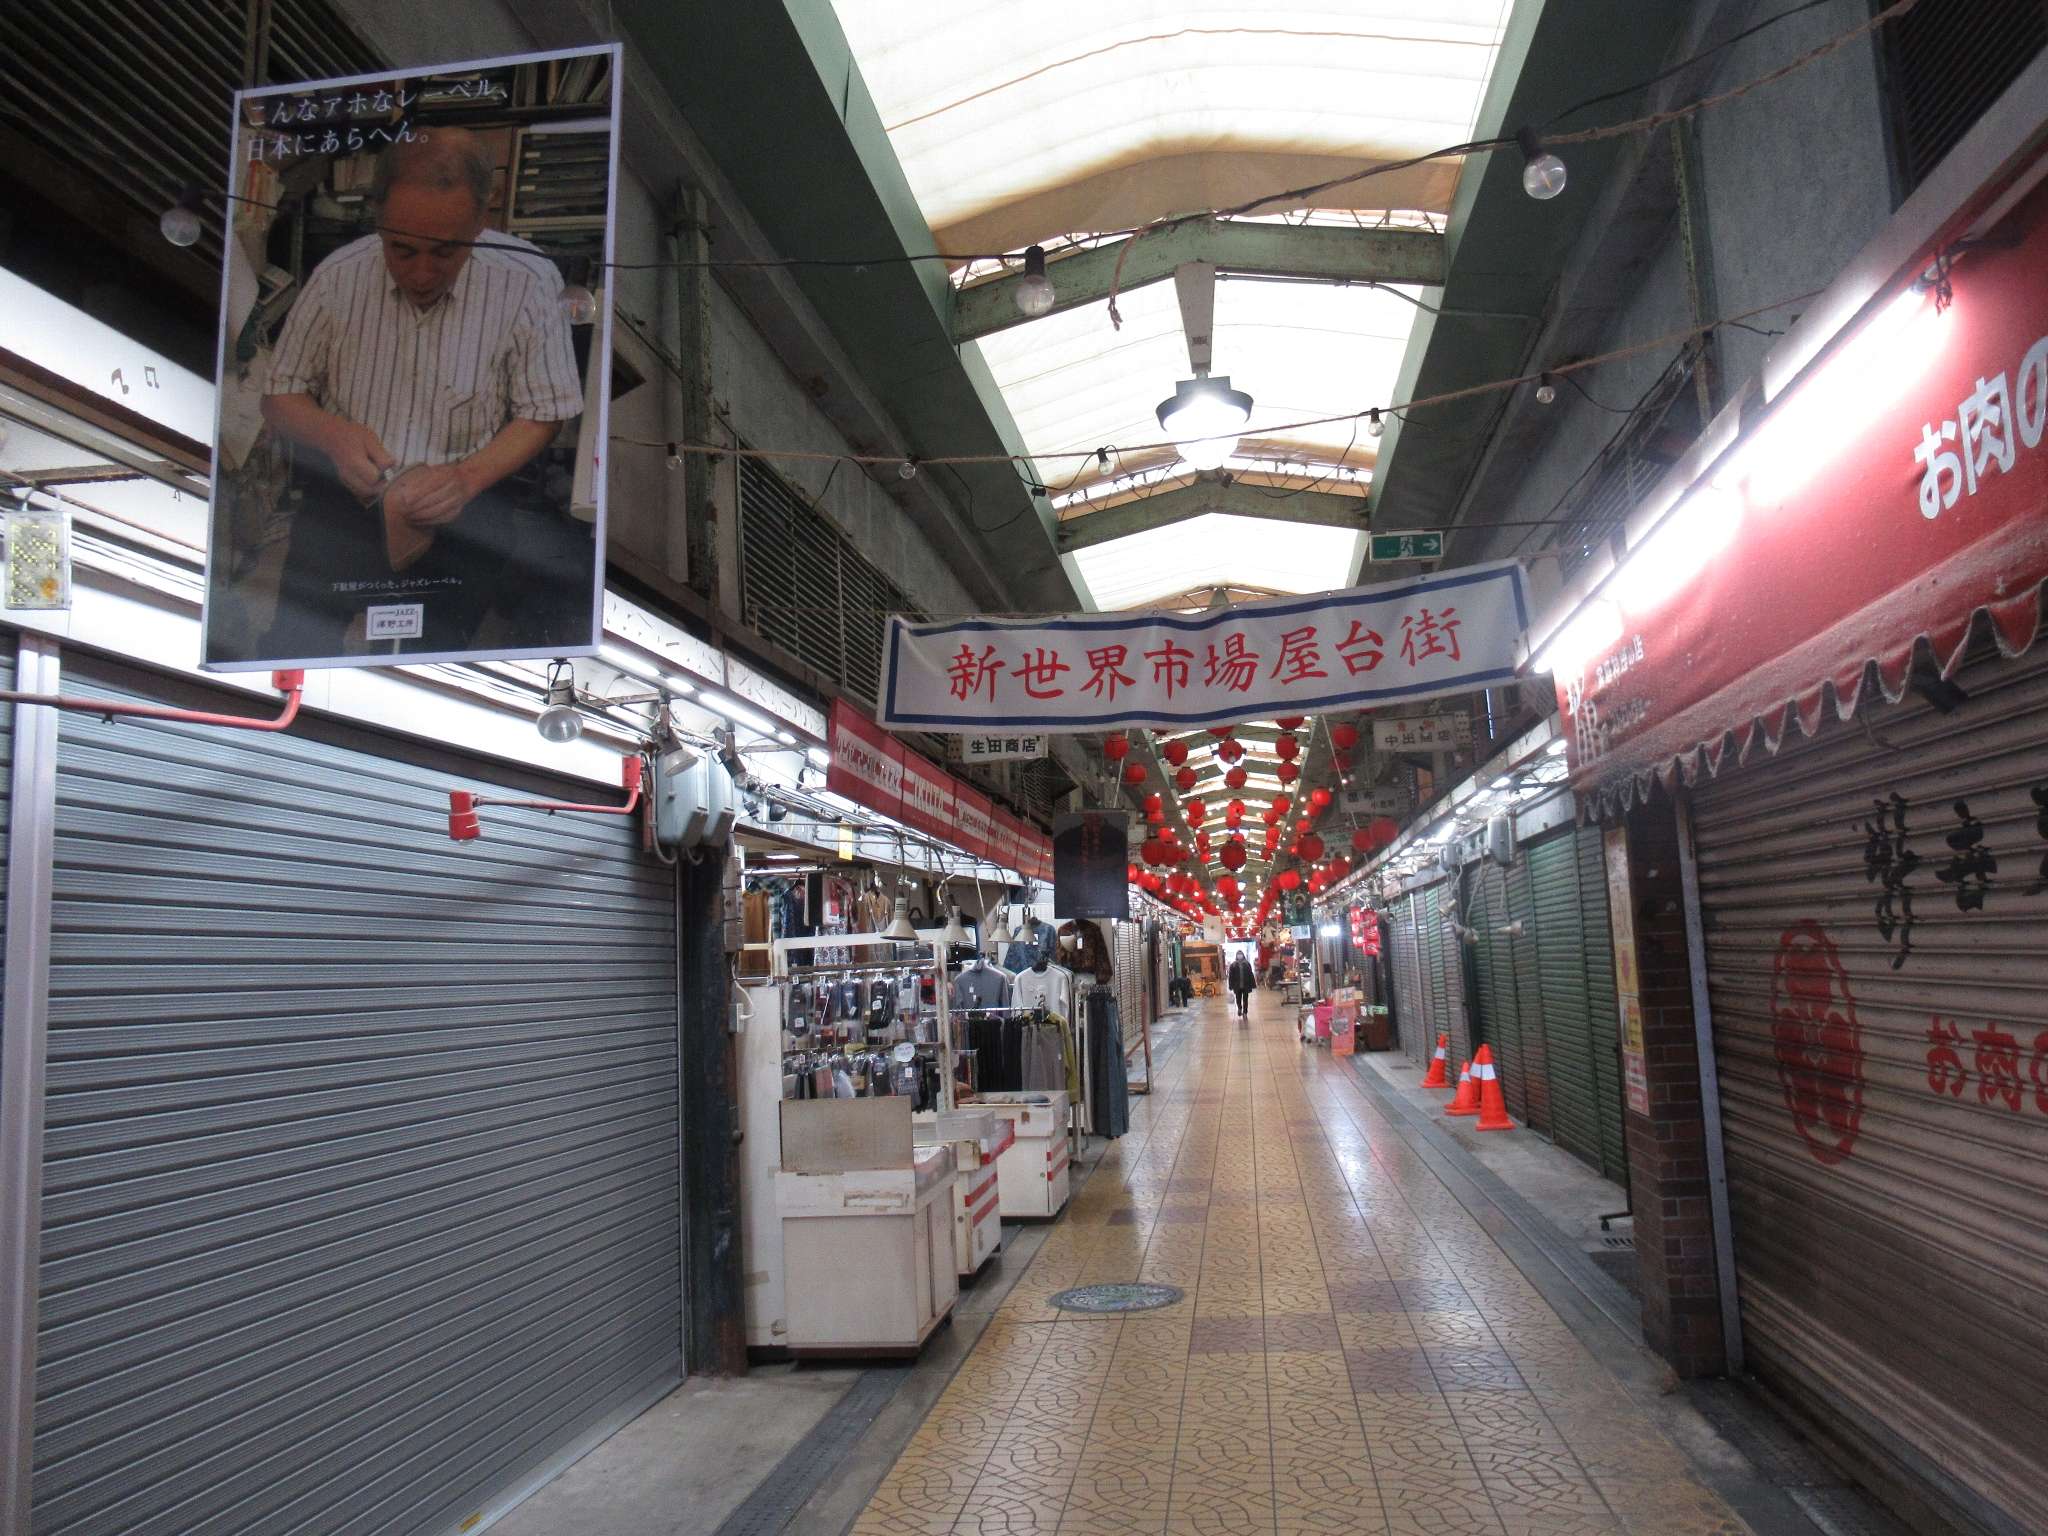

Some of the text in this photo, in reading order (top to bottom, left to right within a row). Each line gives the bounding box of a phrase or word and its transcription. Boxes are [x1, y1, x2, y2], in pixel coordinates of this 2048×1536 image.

[250, 79, 508, 127] こんなアホなレーベル、
[247, 120, 430, 162] 日本にあらへん。
[946, 607, 1462, 702] 新世界市場屋台街
[971, 738, 1037, 754] 生田商店
